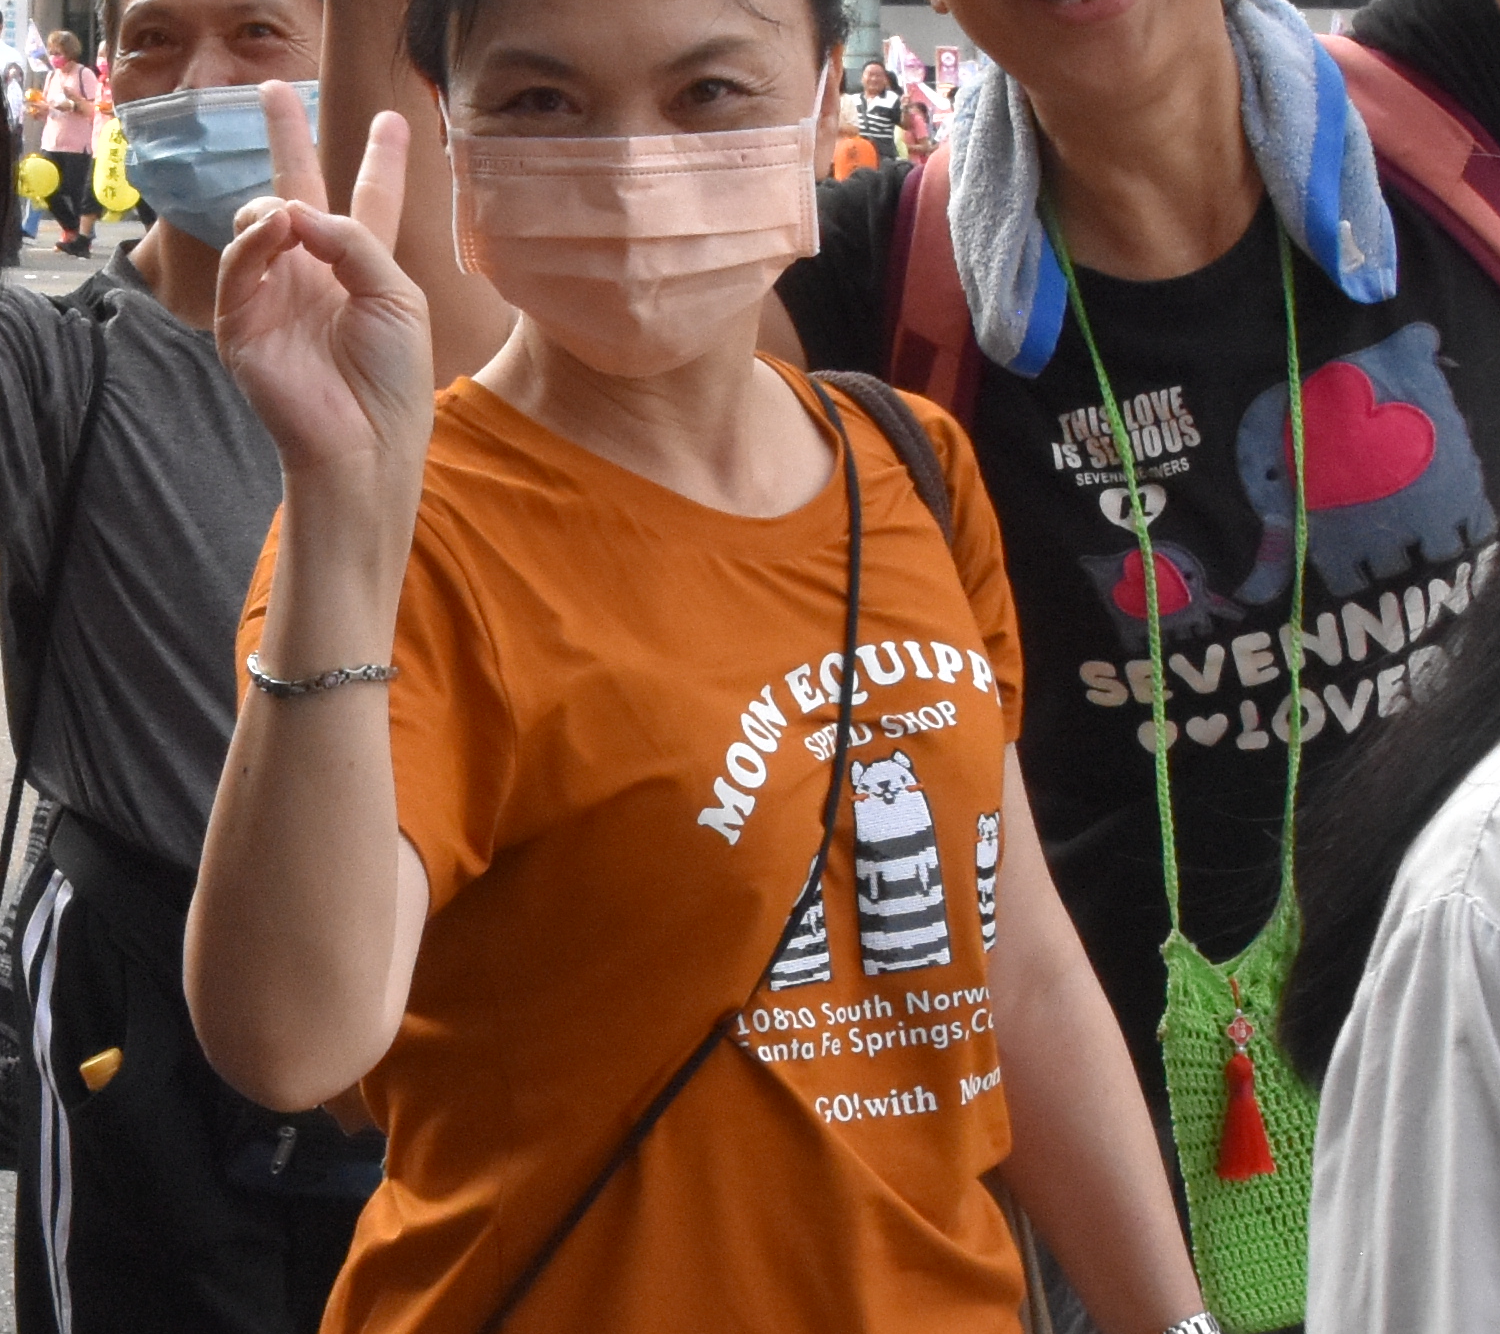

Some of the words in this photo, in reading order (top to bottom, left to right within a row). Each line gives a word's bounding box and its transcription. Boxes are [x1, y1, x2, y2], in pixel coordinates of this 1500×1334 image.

[1058, 406, 1114, 444] THIS
[1122, 385, 1187, 432] LOVE
[1051, 442, 1082, 470] IS
[1086, 414, 1201, 469] SEIOUS
[697, 684, 788, 845] MOON
[784, 640, 1002, 714] EQUIPP
[881, 700, 958, 738] SHOP
[737, 1007, 816, 1037] 10820
[821, 994, 893, 1025] South
[738, 1040, 815, 1063] anta
[821, 1031, 842, 1057] Fe
